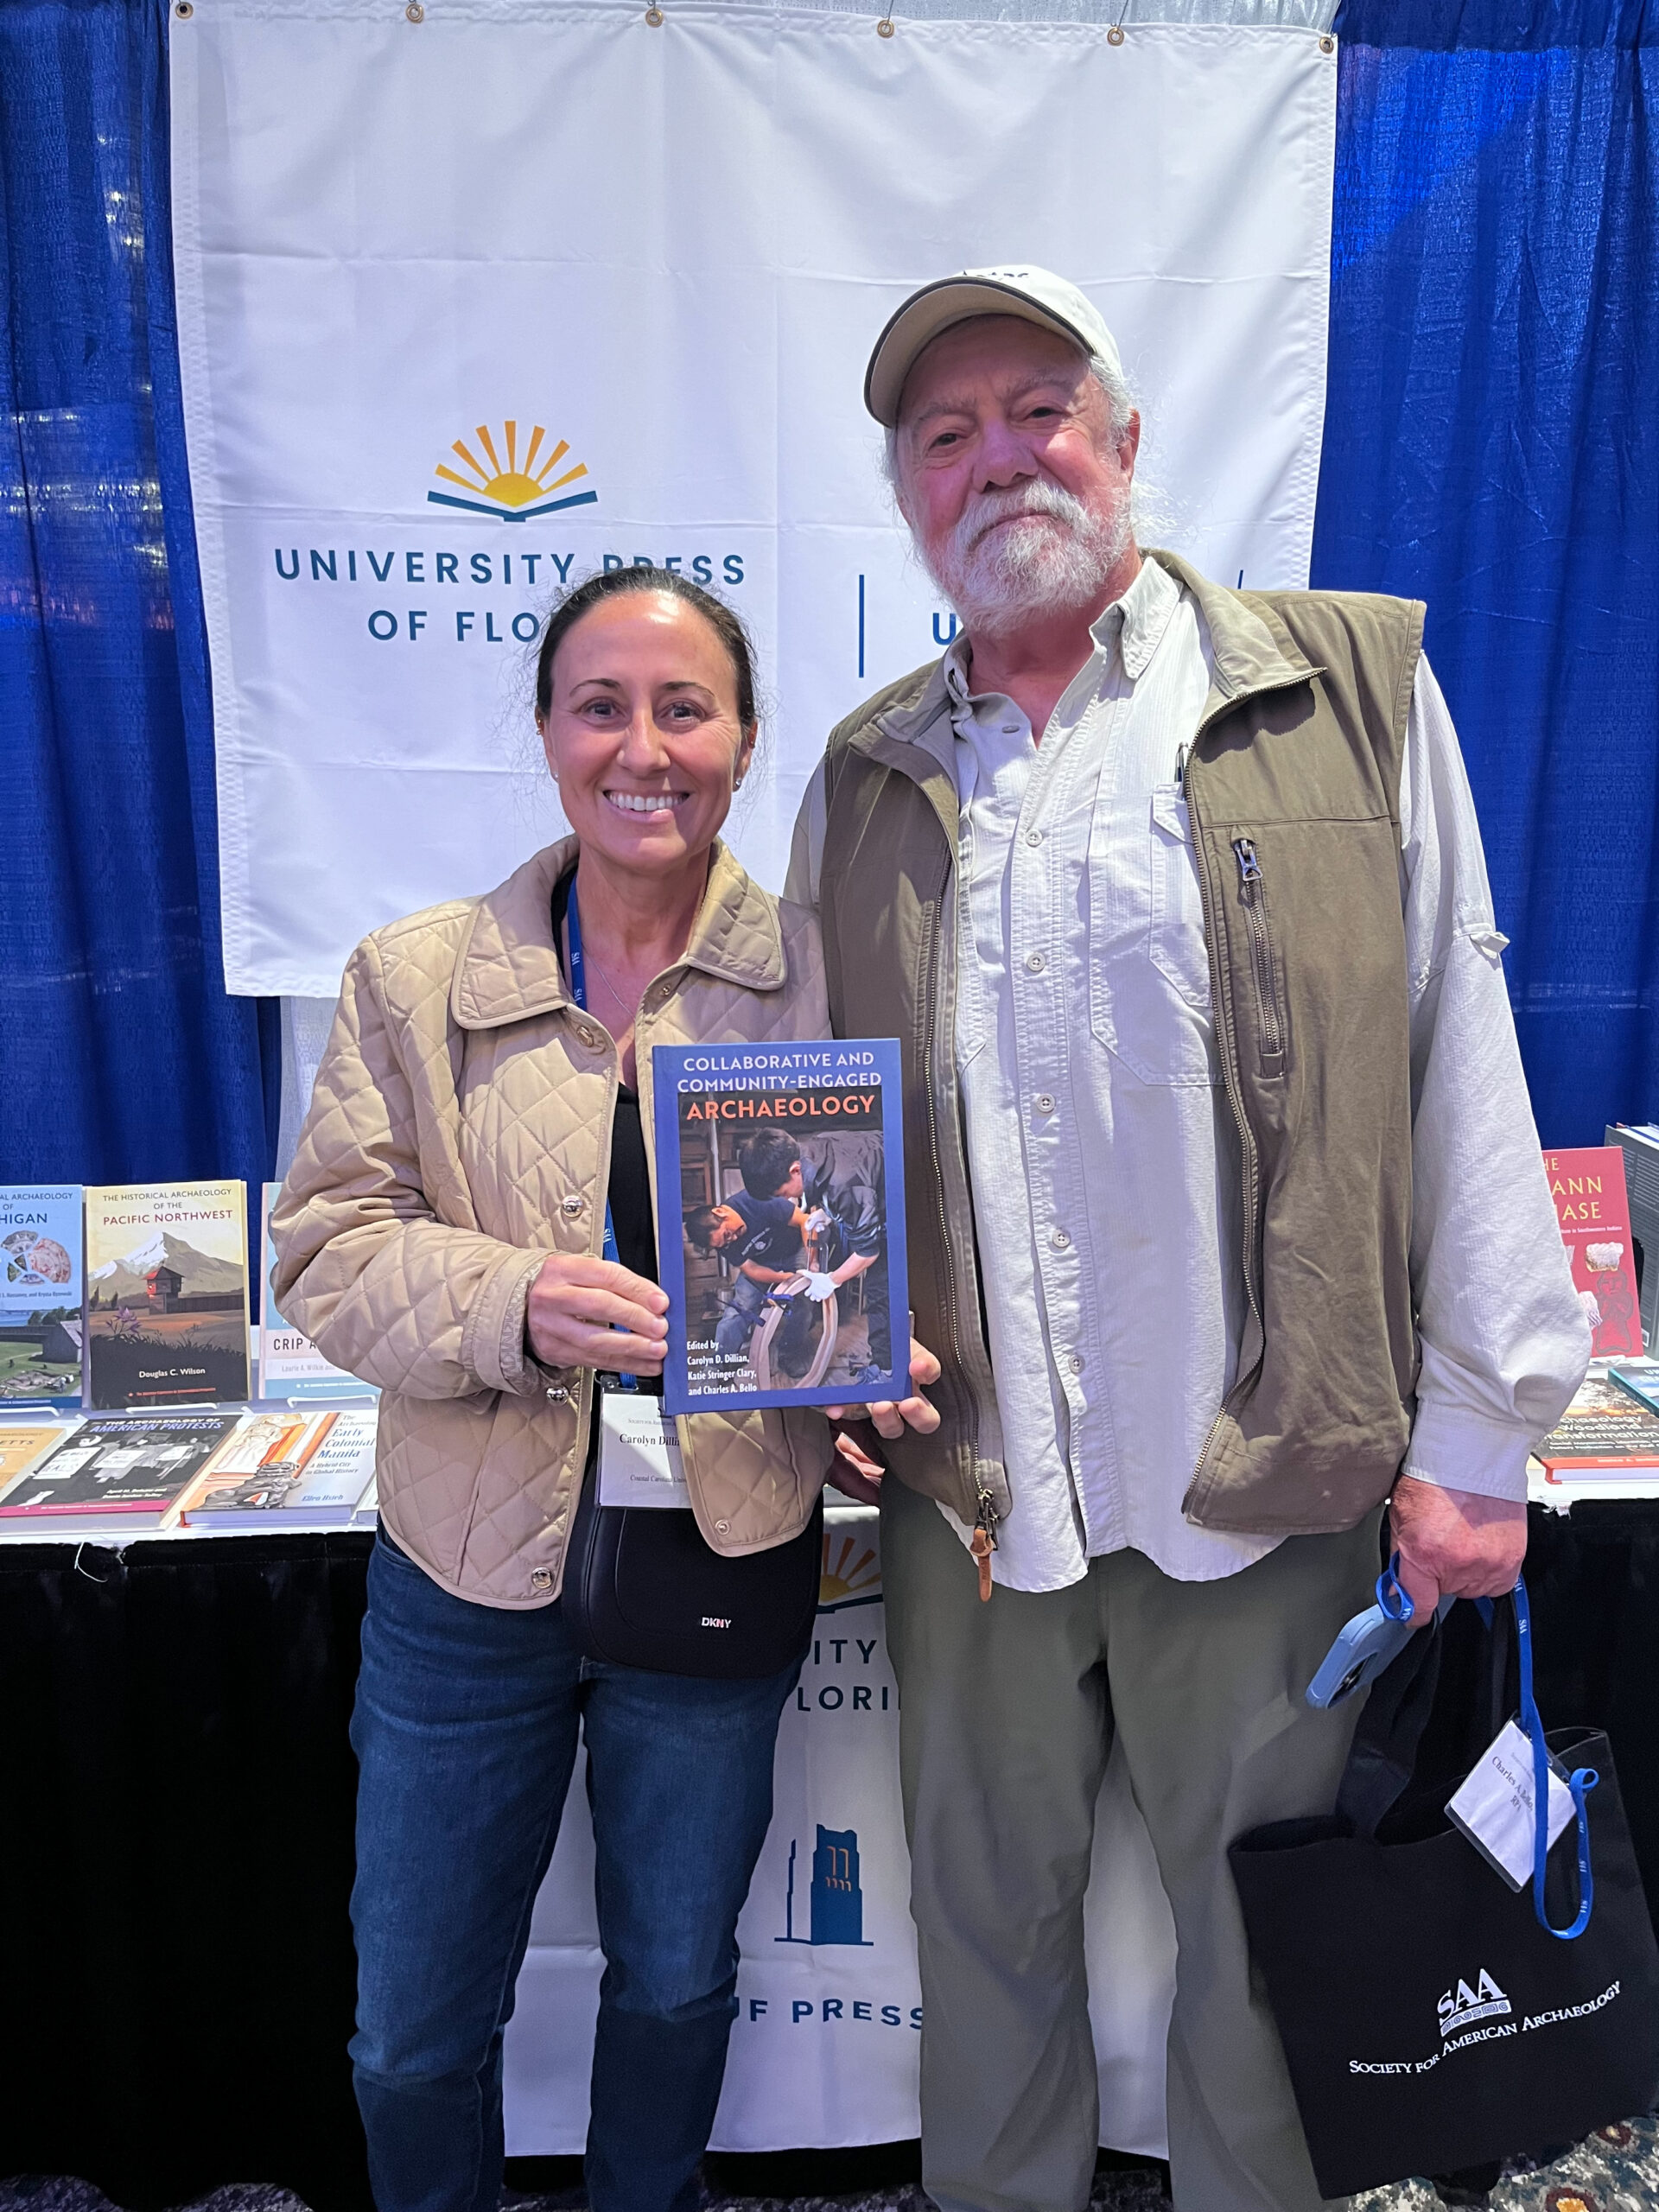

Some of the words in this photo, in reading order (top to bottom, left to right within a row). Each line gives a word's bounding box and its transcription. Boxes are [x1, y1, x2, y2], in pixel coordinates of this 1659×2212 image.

[275, 549, 575, 585] UNIVERSITY
[368, 609, 427, 641] OF
[456, 611, 540, 642] FLO
[683, 1053, 831, 1071] COLLABORATIVE
[836, 1052, 874, 1066] AND
[677, 1072, 882, 1093] COMMUNITY-ENGAGED
[686, 1095, 875, 1121] ARCHAEOLOGY
[121, 1192, 168, 1201] HISTORICAL
[170, 1188, 232, 1199] ARCHAEOLOGY
[103, 1214, 149, 1225] PACIFIC
[155, 1210, 232, 1222] NORTHWEST
[1554, 1201, 1601, 1220] ASE
[273, 1338, 303, 1351] CRIP
[687, 1340, 709, 1351] Edited
[710, 1340, 719, 1351] by
[688, 1356, 714, 1366] Carolyn
[715, 1354, 723, 1363] D.
[725, 1353, 749, 1363] Dillian,
[139, 1370, 168, 1379] Douglas
[180, 1367, 206, 1376] Wilson
[688, 1370, 706, 1380] Katie
[708, 1369, 735, 1381] Stringer
[737, 1368, 757, 1380] Clary,
[689, 1386, 702, 1395] and
[703, 1384, 728, 1394] Charles
[731, 1383, 738, 1393] A.
[740, 1382, 758, 1393] Bello
[89, 1423, 158, 1433] AMERICAN
[159, 1421, 225, 1431] PROTESTS
[332, 1428, 364, 1437] Early
[326, 1438, 376, 1447] Colonial
[620, 1434, 656, 1446] Carolyn
[318, 1449, 360, 1459] Manila
[702, 1617, 732, 1629] DKNY
[814, 1639, 878, 1665] ITY
[797, 1685, 901, 1712] LORI
[1491, 1756, 1516, 1786] Charles
[1437, 1968, 1507, 2026] SAA
[791, 1998, 923, 2030] PRESS
[1349, 2060, 1412, 2073] SOCIETY
[1442, 2023, 1517, 2057] AMERICAN
[1522, 1980, 1620, 2031] ARCHAEOLOGY
